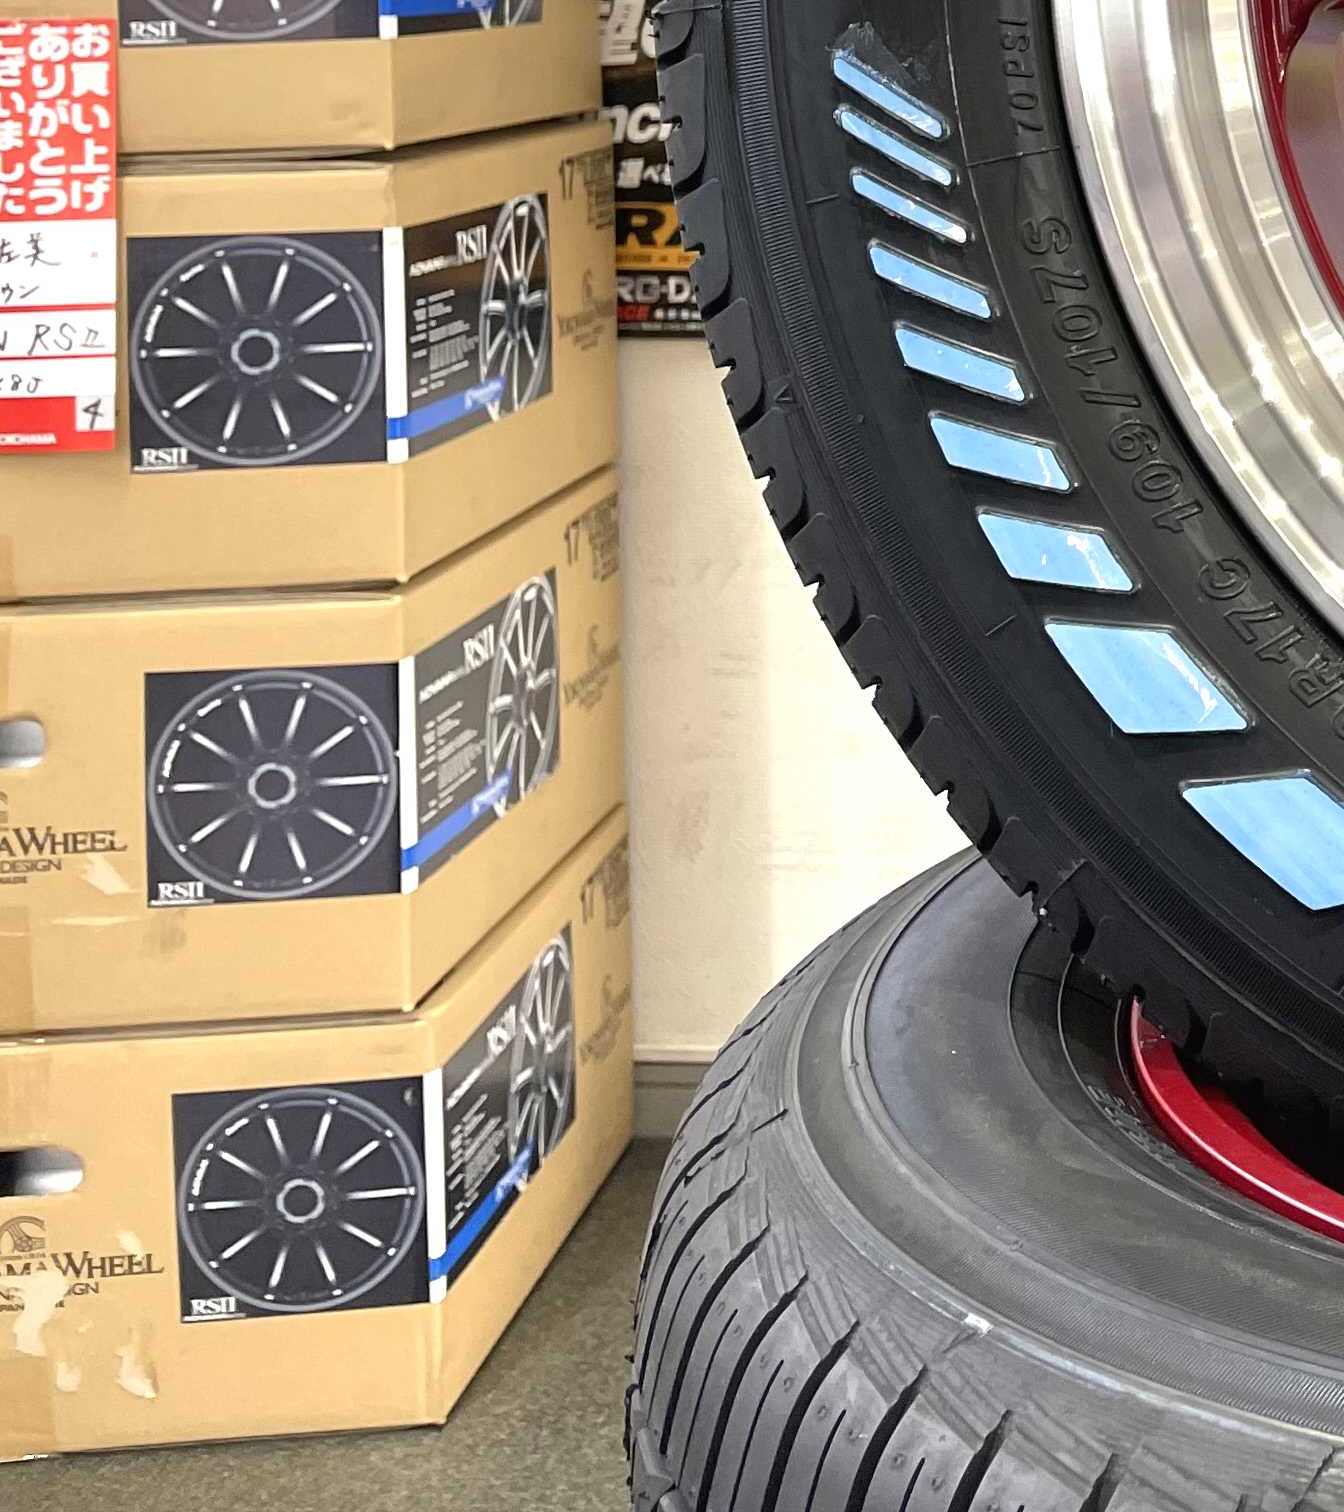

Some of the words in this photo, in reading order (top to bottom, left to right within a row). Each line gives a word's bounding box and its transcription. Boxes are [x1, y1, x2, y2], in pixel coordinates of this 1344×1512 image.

[28, 24, 71, 215] ありがとう
[69, 23, 111, 212] お買い上げ
[82, 399, 103, 429] 4
[1021, 216, 1206, 535] 109/107S
[13, 825, 128, 856] WHEEL
[51, 1250, 164, 1279] WHEEL
